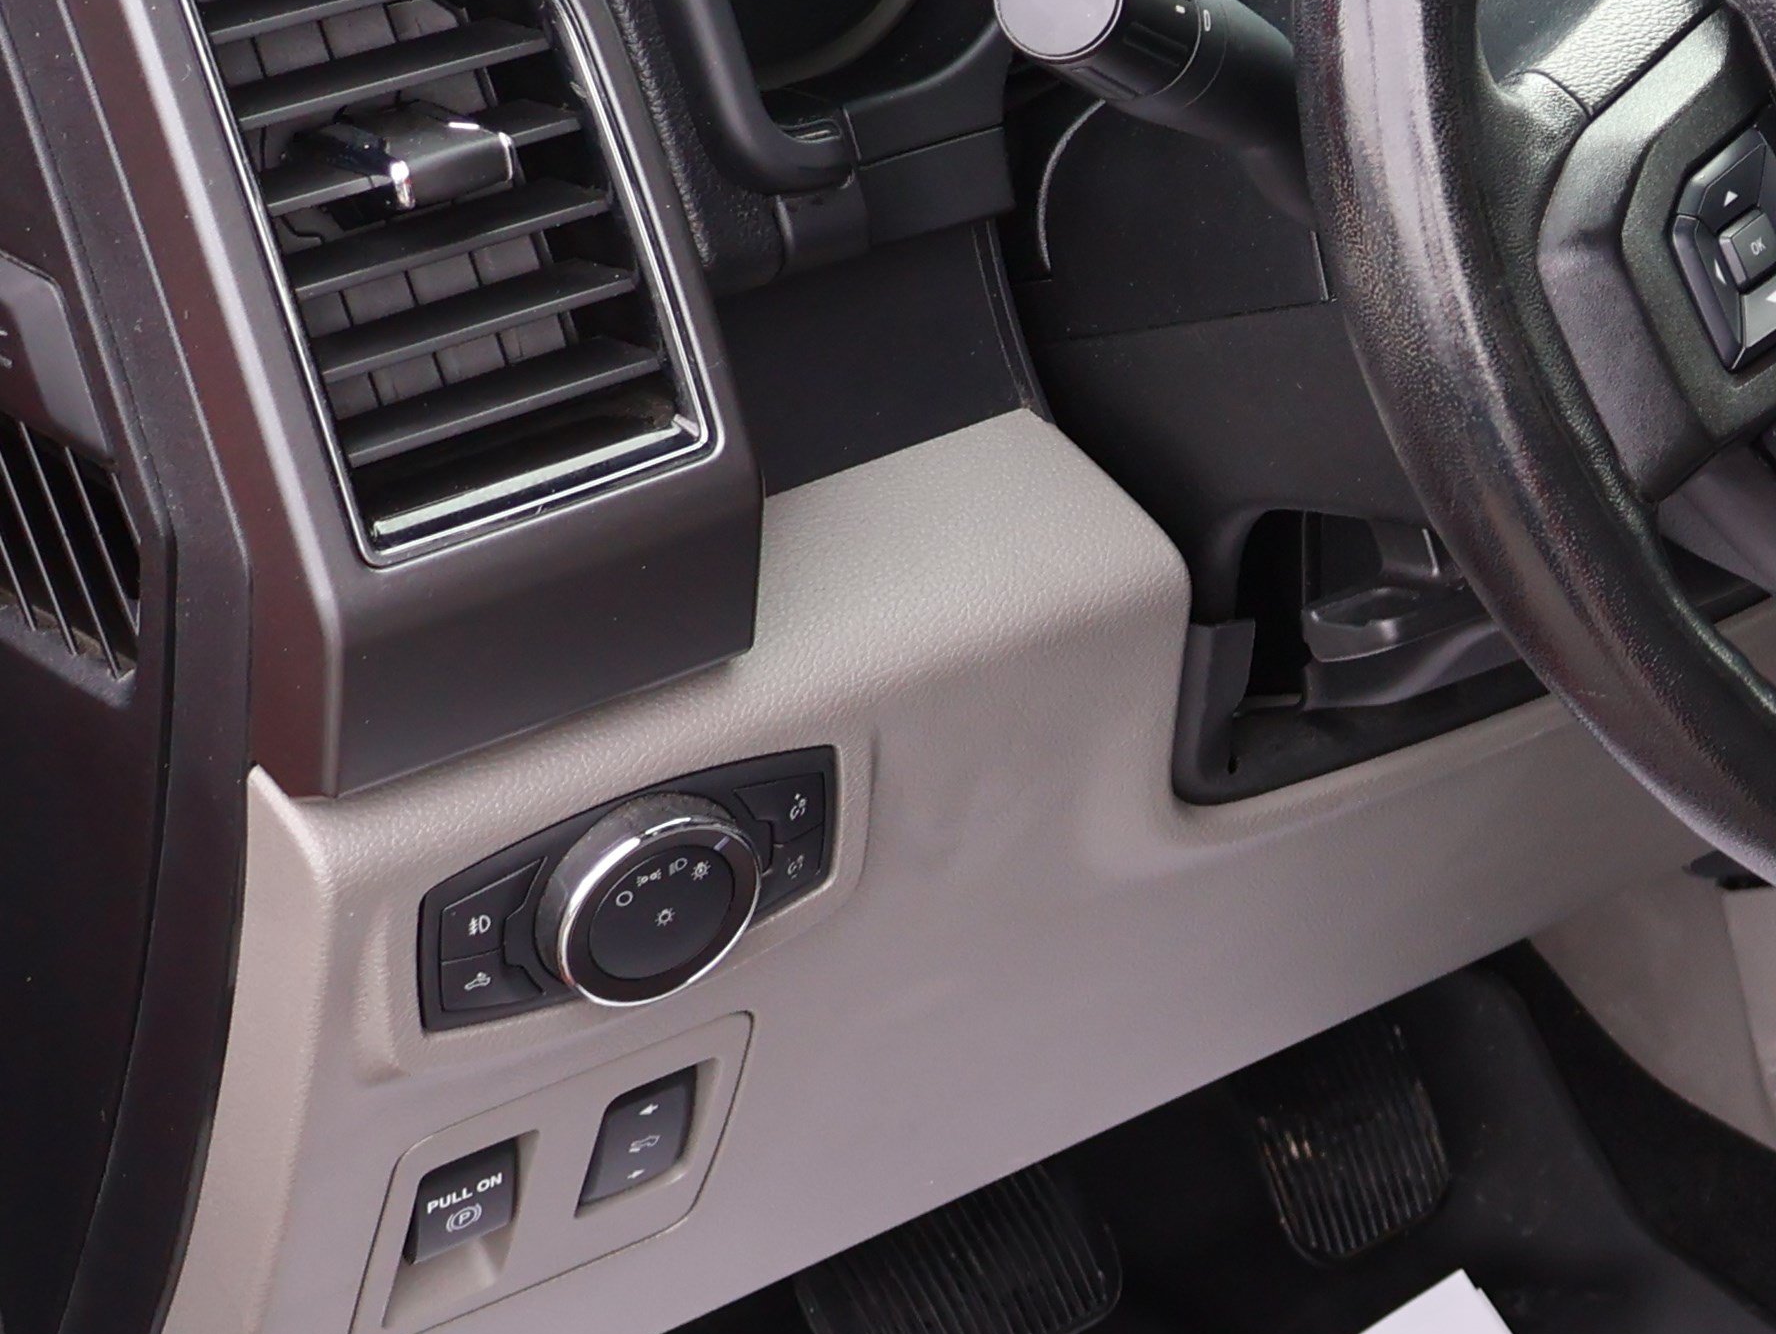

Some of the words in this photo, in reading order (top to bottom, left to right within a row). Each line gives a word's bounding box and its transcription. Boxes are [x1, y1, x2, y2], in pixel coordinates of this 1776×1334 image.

[1750, 237, 1767, 255] OK
[426, 1187, 473, 1214] PULL
[476, 1172, 503, 1193] ON
